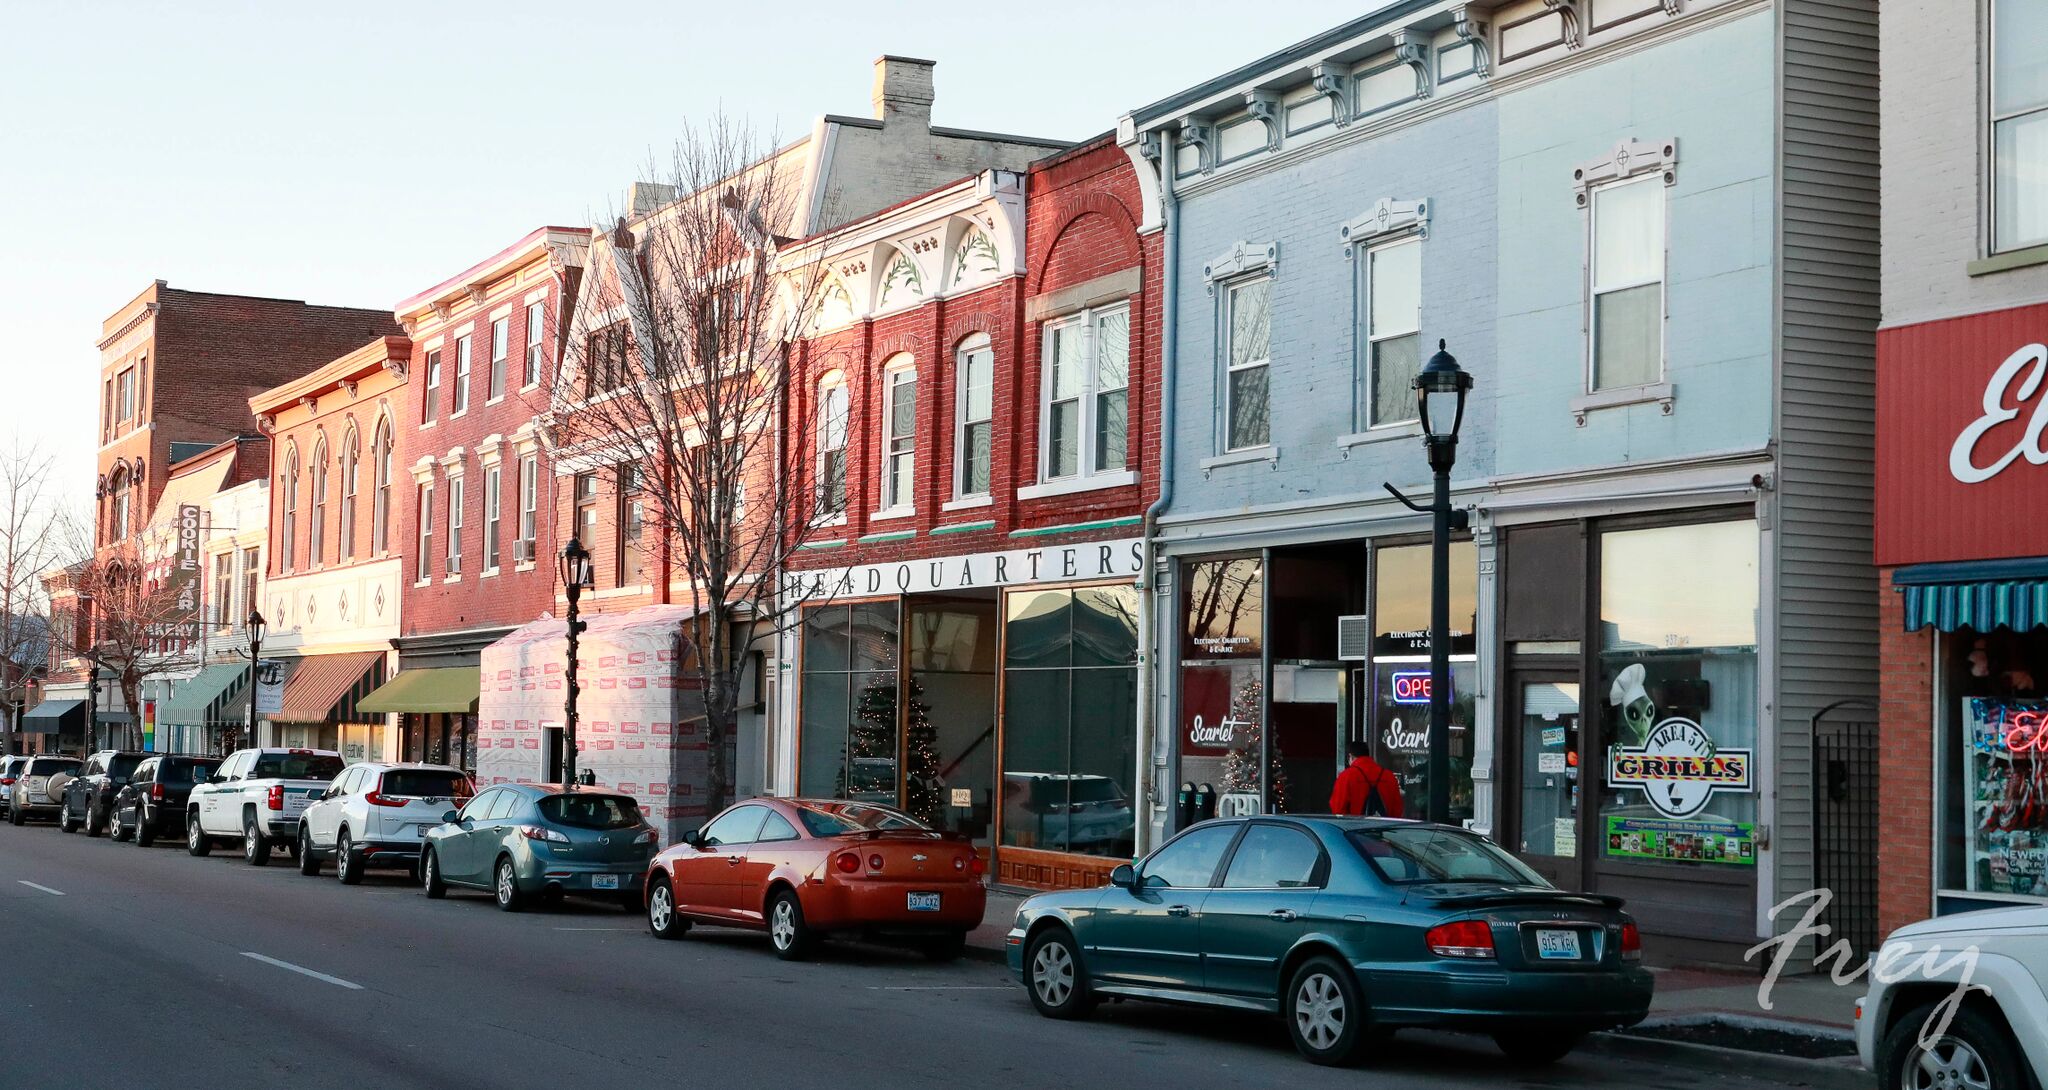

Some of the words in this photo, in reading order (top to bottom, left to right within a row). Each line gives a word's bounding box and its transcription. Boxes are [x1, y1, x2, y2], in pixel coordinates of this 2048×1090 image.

[181, 506, 198, 571] COOKIE
[789, 541, 1145, 600] HEADQUARTERS
[178, 578, 196, 611] JAR
[1396, 679, 1431, 697] OPE
[1190, 714, 1252, 743] Scarlet
[1386, 717, 1436, 750] Scarl
[1653, 725, 1686, 752] AREA
[1688, 731, 1706, 753] 51
[1616, 758, 1743, 779] GRILLS
[1542, 938, 1557, 951] 915
